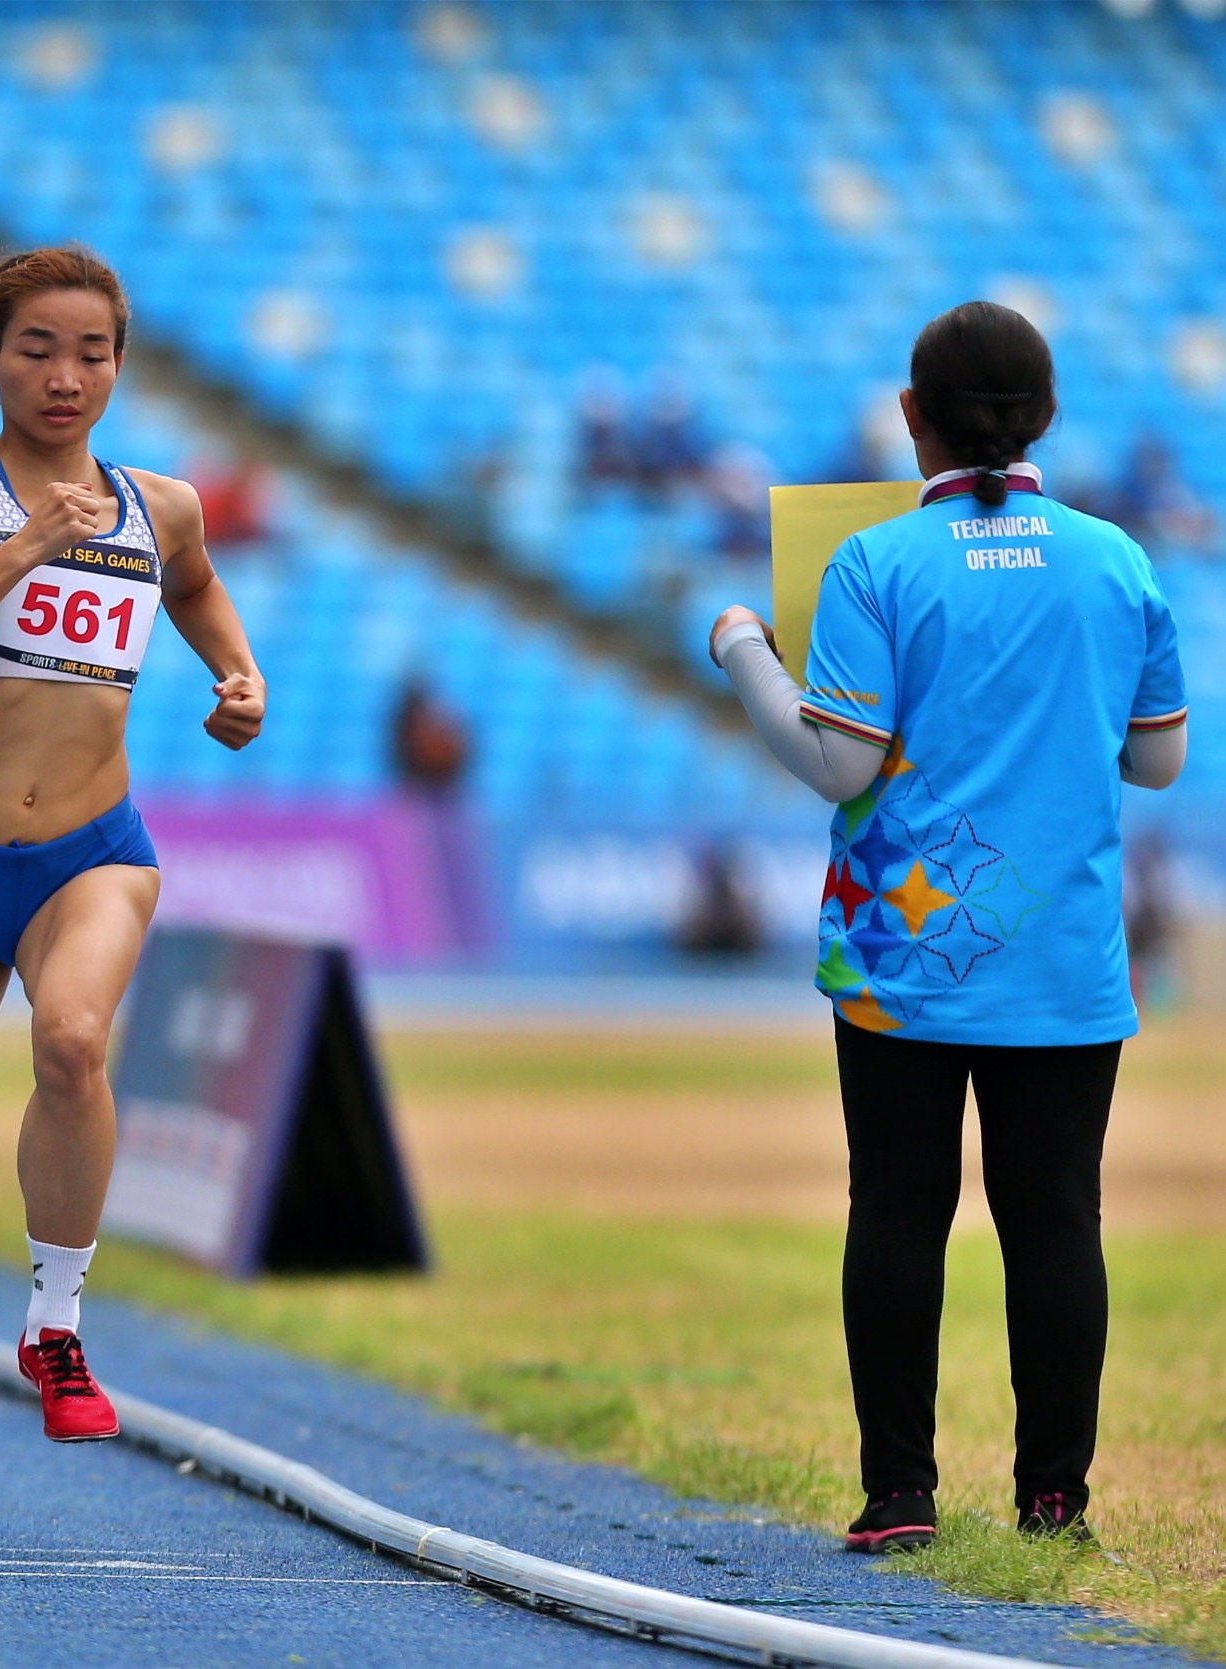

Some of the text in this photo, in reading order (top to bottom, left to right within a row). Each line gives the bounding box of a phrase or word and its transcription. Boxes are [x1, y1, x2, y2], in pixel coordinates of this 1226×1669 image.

[948, 516, 1053, 540] TECHNICAL
[75, 549, 104, 565] SEA
[108, 554, 150, 573] GAMES
[966, 547, 1047, 570] OFFICIAL
[17, 582, 135, 650] 561
[19, 653, 56, 669] SPORTS
[91, 666, 117, 680] PEACE
